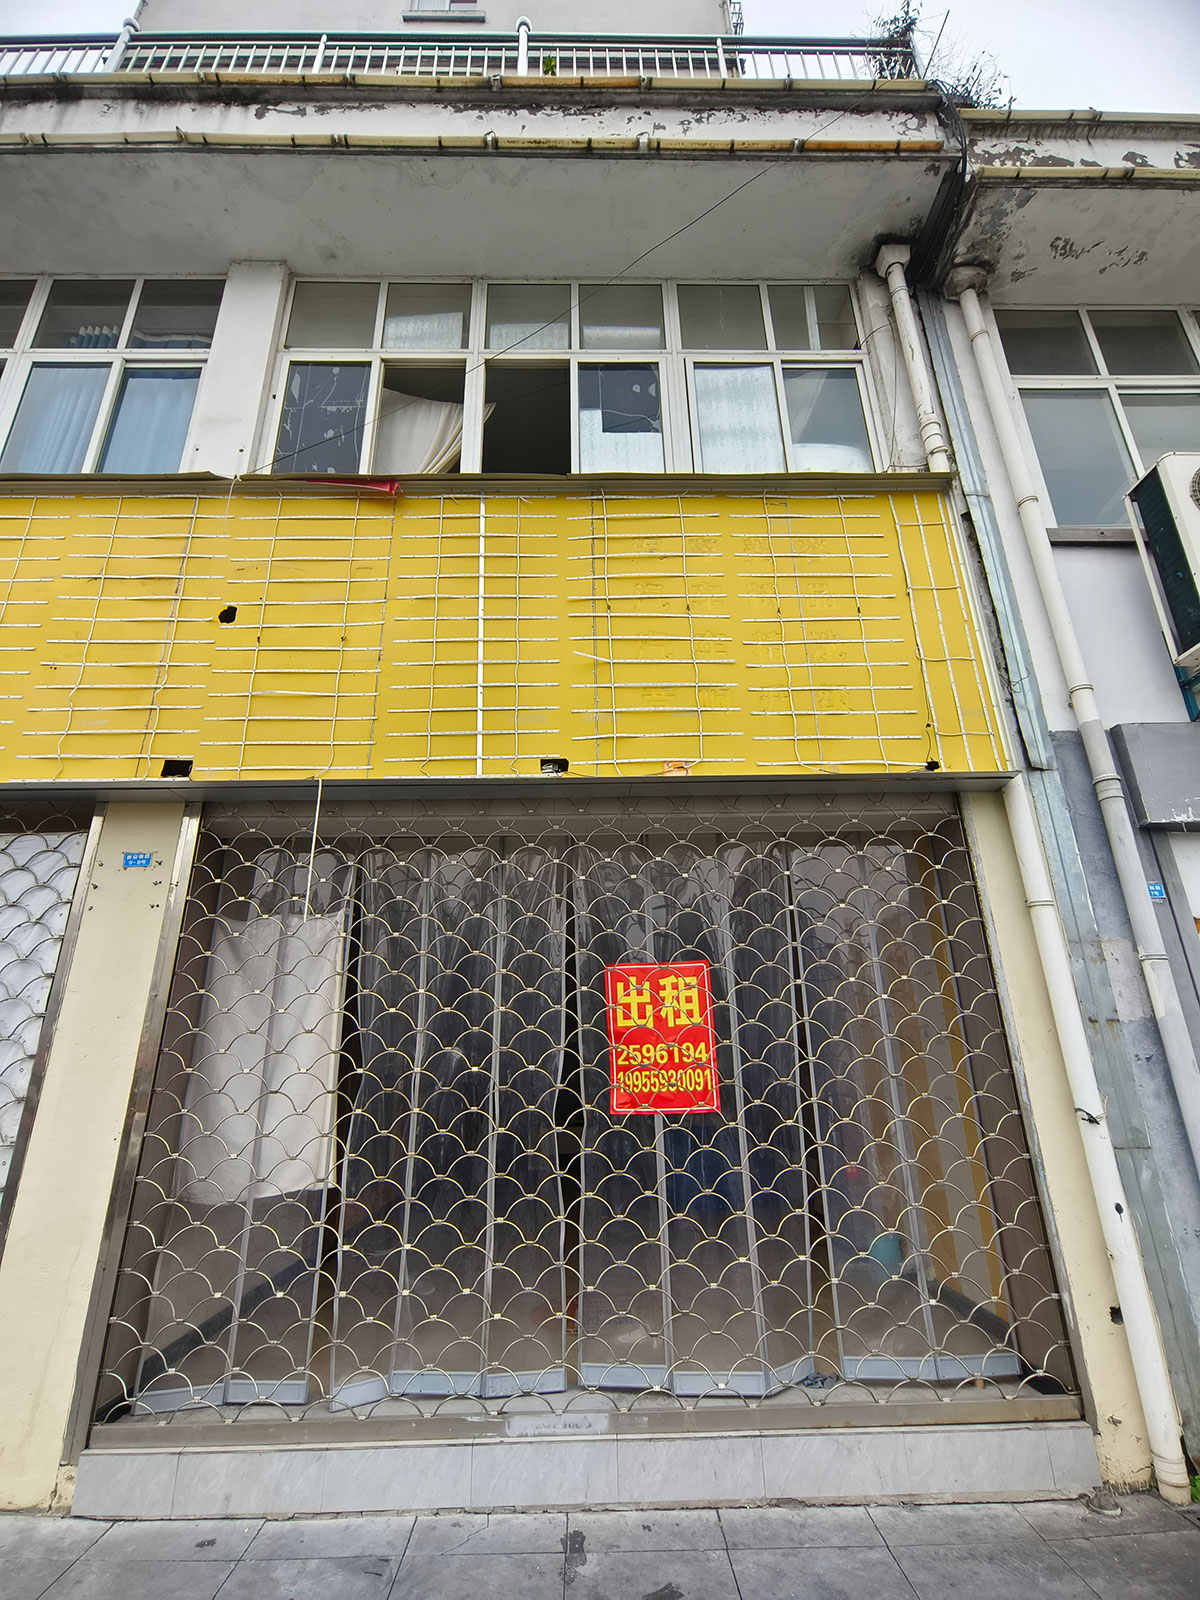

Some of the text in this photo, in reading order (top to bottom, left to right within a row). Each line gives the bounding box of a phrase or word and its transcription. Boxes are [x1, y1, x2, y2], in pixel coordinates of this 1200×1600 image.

[617, 975, 704, 1028] 出租
[617, 1042, 708, 1065] 2596194
[617, 1069, 712, 1094] 19955930091
